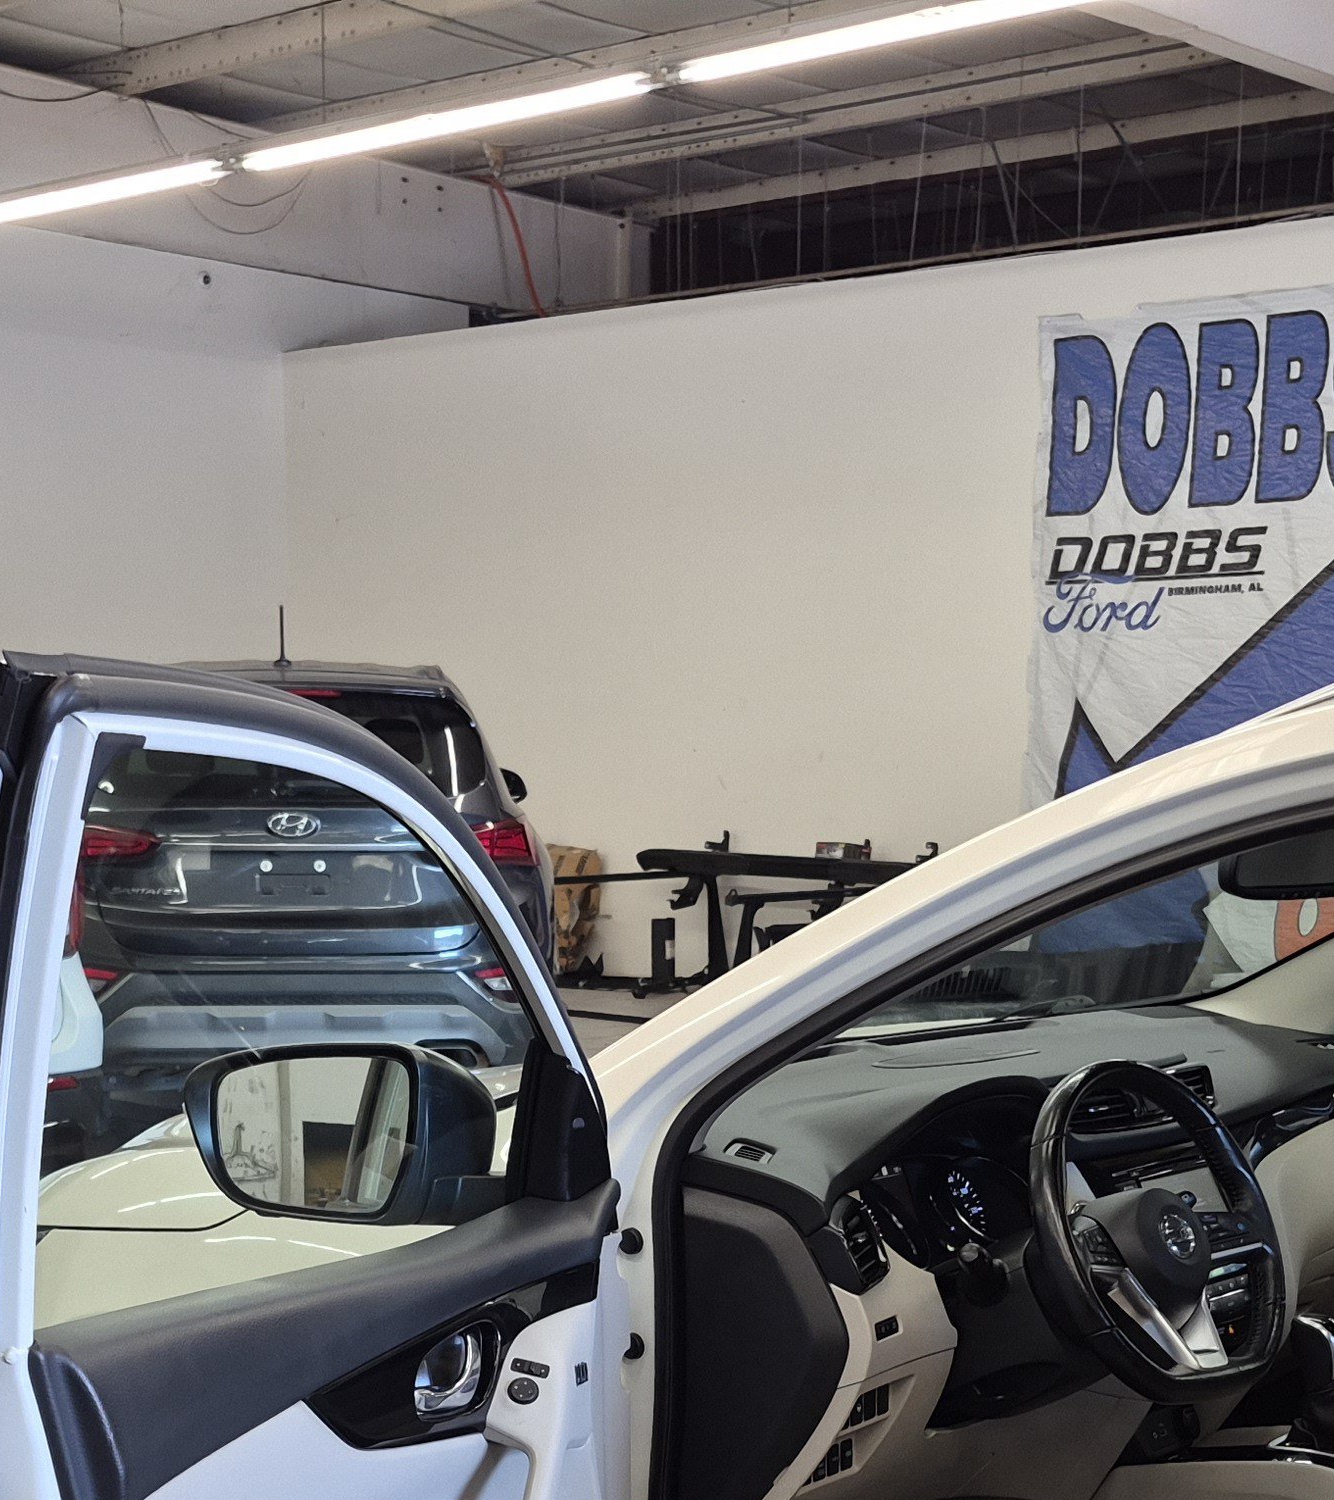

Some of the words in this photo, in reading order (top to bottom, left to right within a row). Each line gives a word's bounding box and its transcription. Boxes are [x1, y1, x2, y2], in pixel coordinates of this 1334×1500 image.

[1049, 526, 1268, 579] DOBBS
[1043, 572, 1165, 633] Ford
[1167, 583, 1244, 596] BIRMINGHAM,
[1248, 582, 1264, 592] AL
